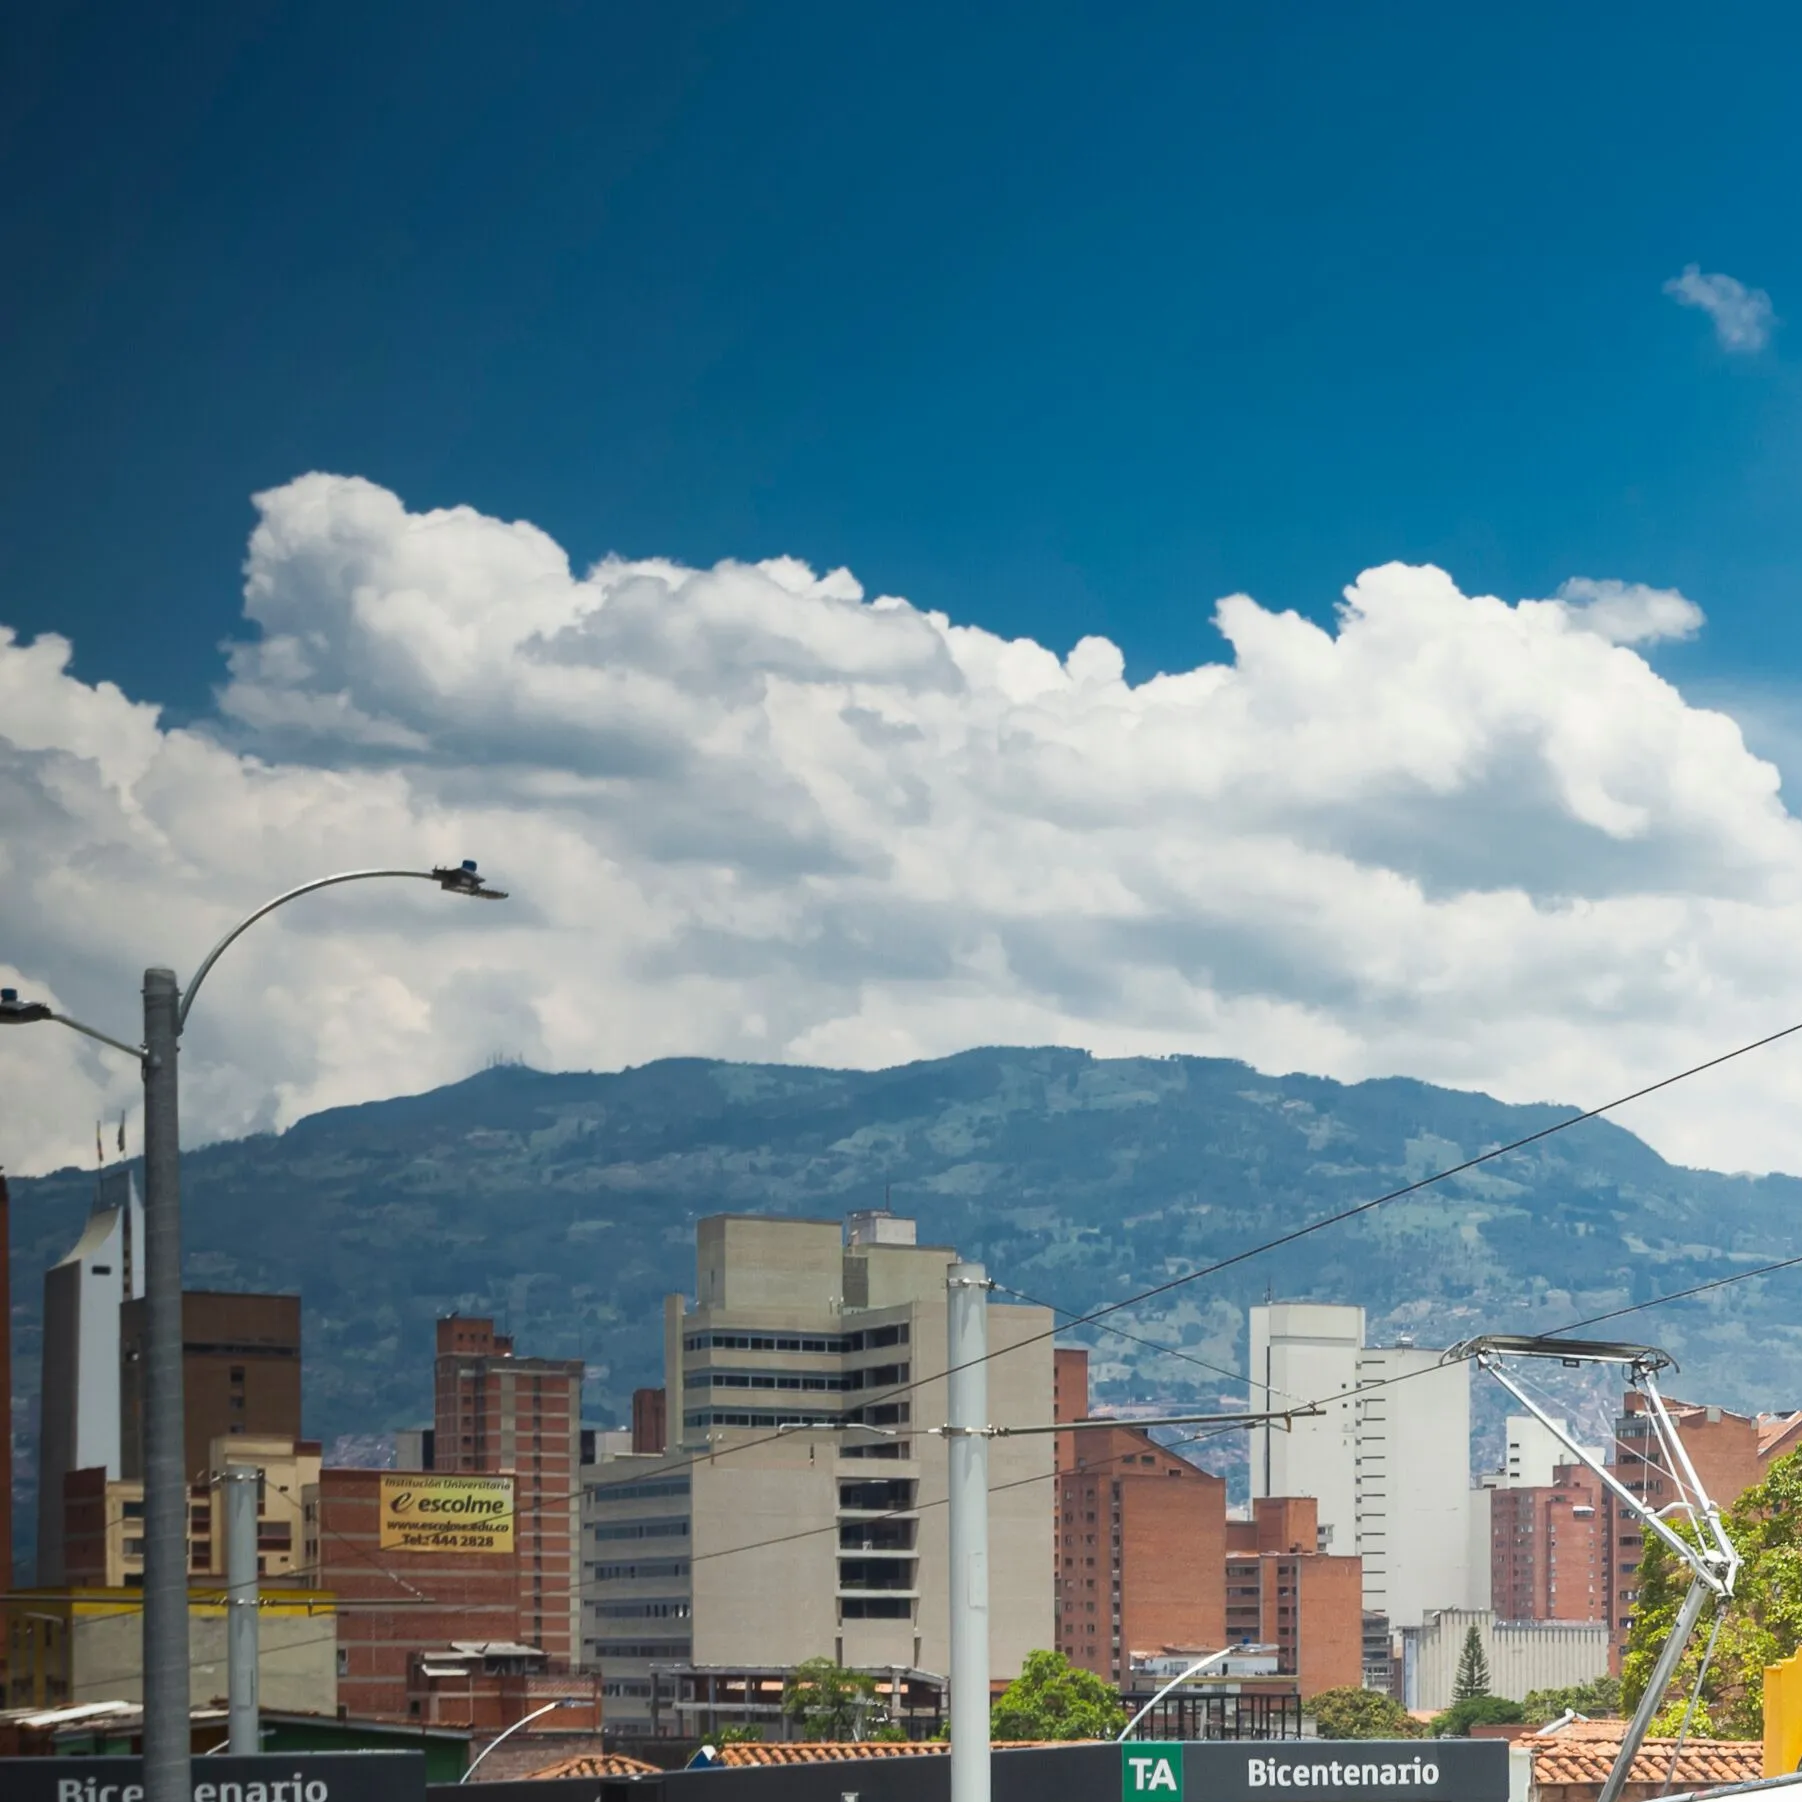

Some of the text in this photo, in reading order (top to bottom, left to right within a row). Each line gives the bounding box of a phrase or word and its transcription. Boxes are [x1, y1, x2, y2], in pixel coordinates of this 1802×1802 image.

[418, 1494, 505, 1514] escolme
[432, 1535, 457, 1547] 444
[460, 1535, 494, 1548] 2828
[1247, 1756, 1440, 1787] Bicentenario
